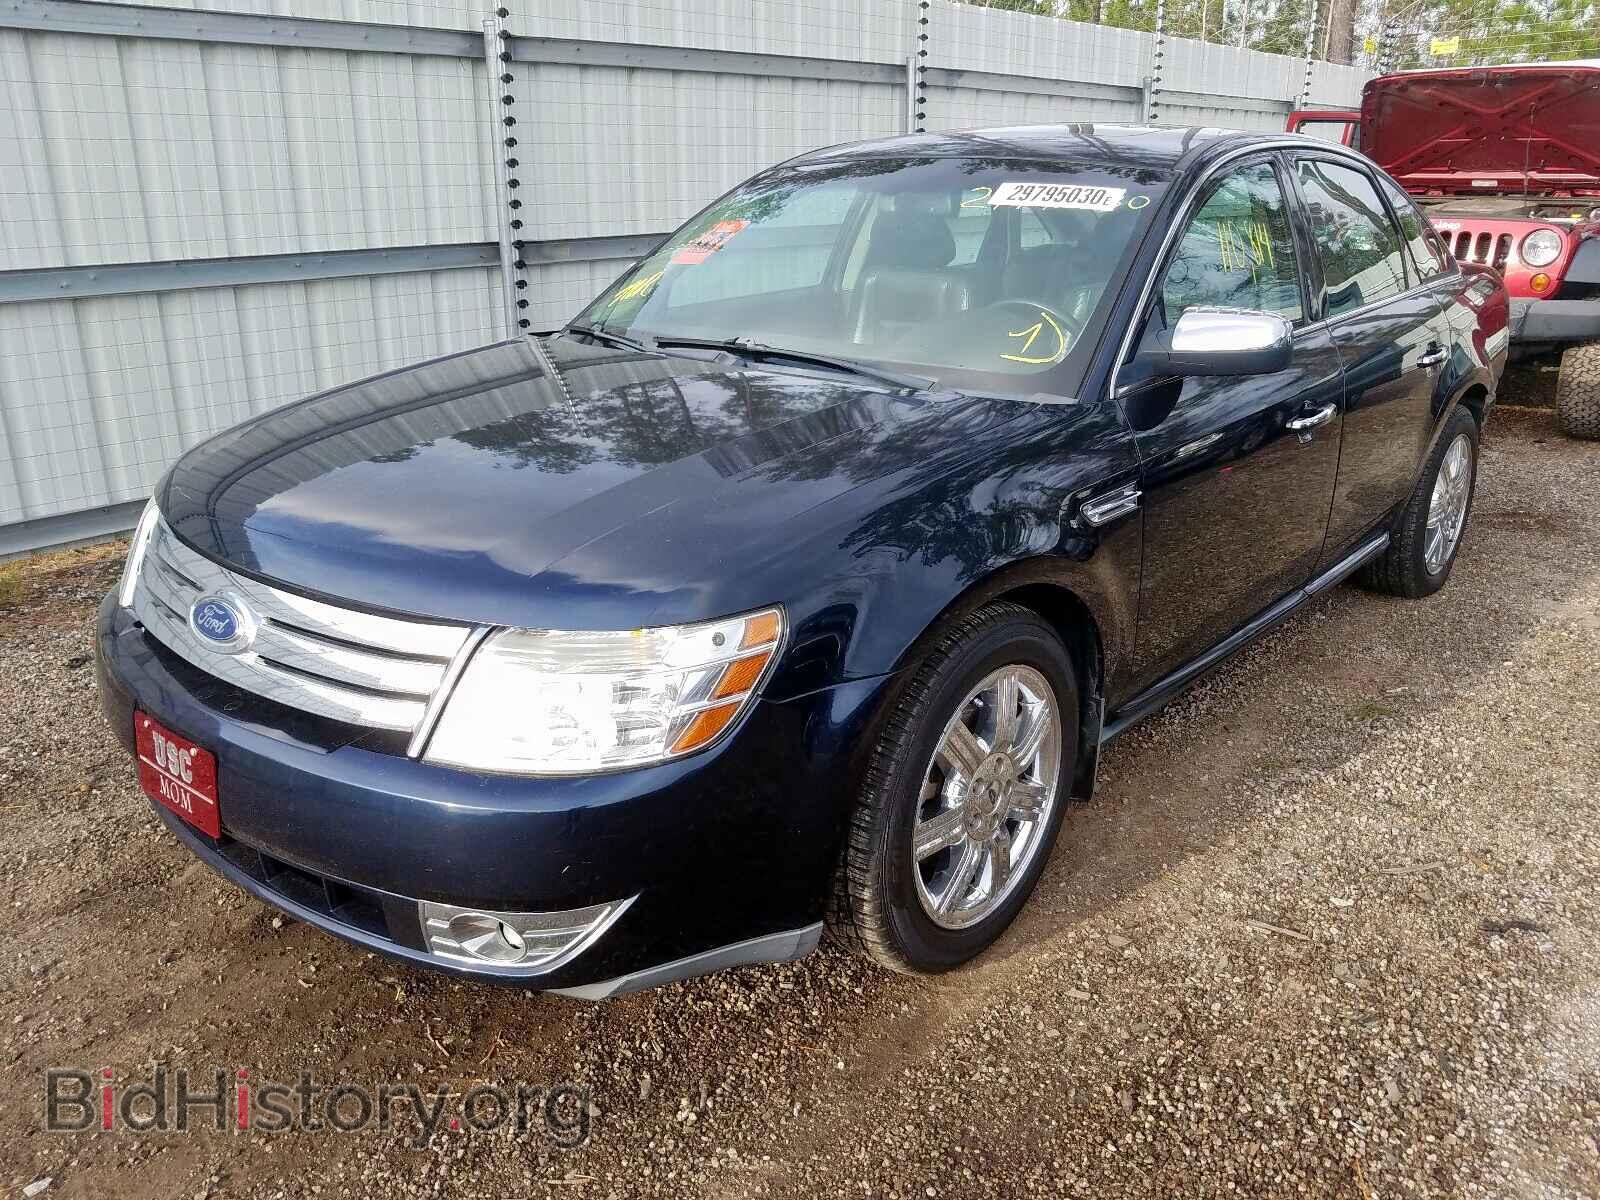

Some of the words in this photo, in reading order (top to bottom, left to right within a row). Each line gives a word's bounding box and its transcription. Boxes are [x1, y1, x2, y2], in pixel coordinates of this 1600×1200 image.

[197, 604, 231, 634] Ford
[152, 732, 193, 784] USC
[159, 775, 193, 814] MOM
